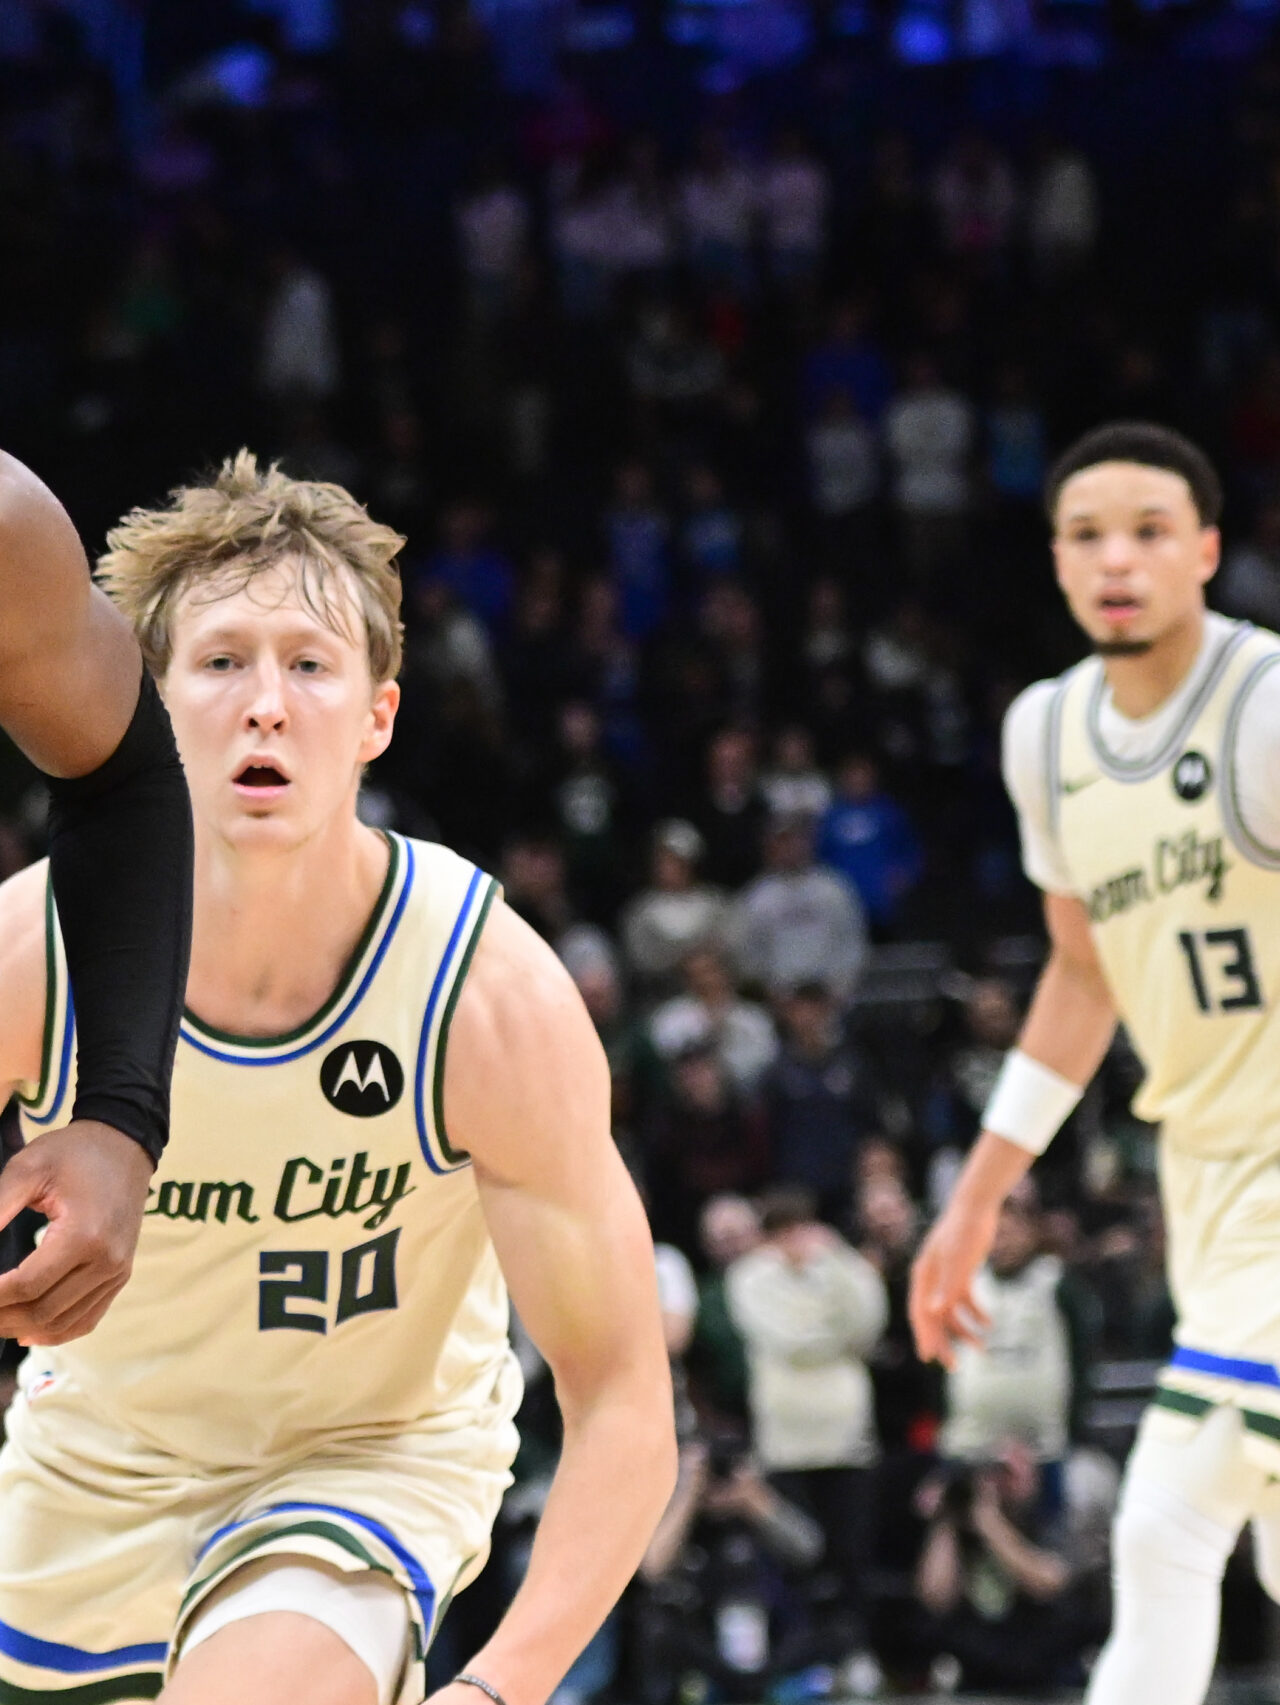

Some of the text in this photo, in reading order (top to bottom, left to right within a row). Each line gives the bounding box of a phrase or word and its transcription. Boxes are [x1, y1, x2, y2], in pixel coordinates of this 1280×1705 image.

[1155, 828, 1232, 902] City
[1179, 928, 1263, 1013] 13
[273, 1150, 417, 1230] City
[258, 1226, 403, 1335] 20
